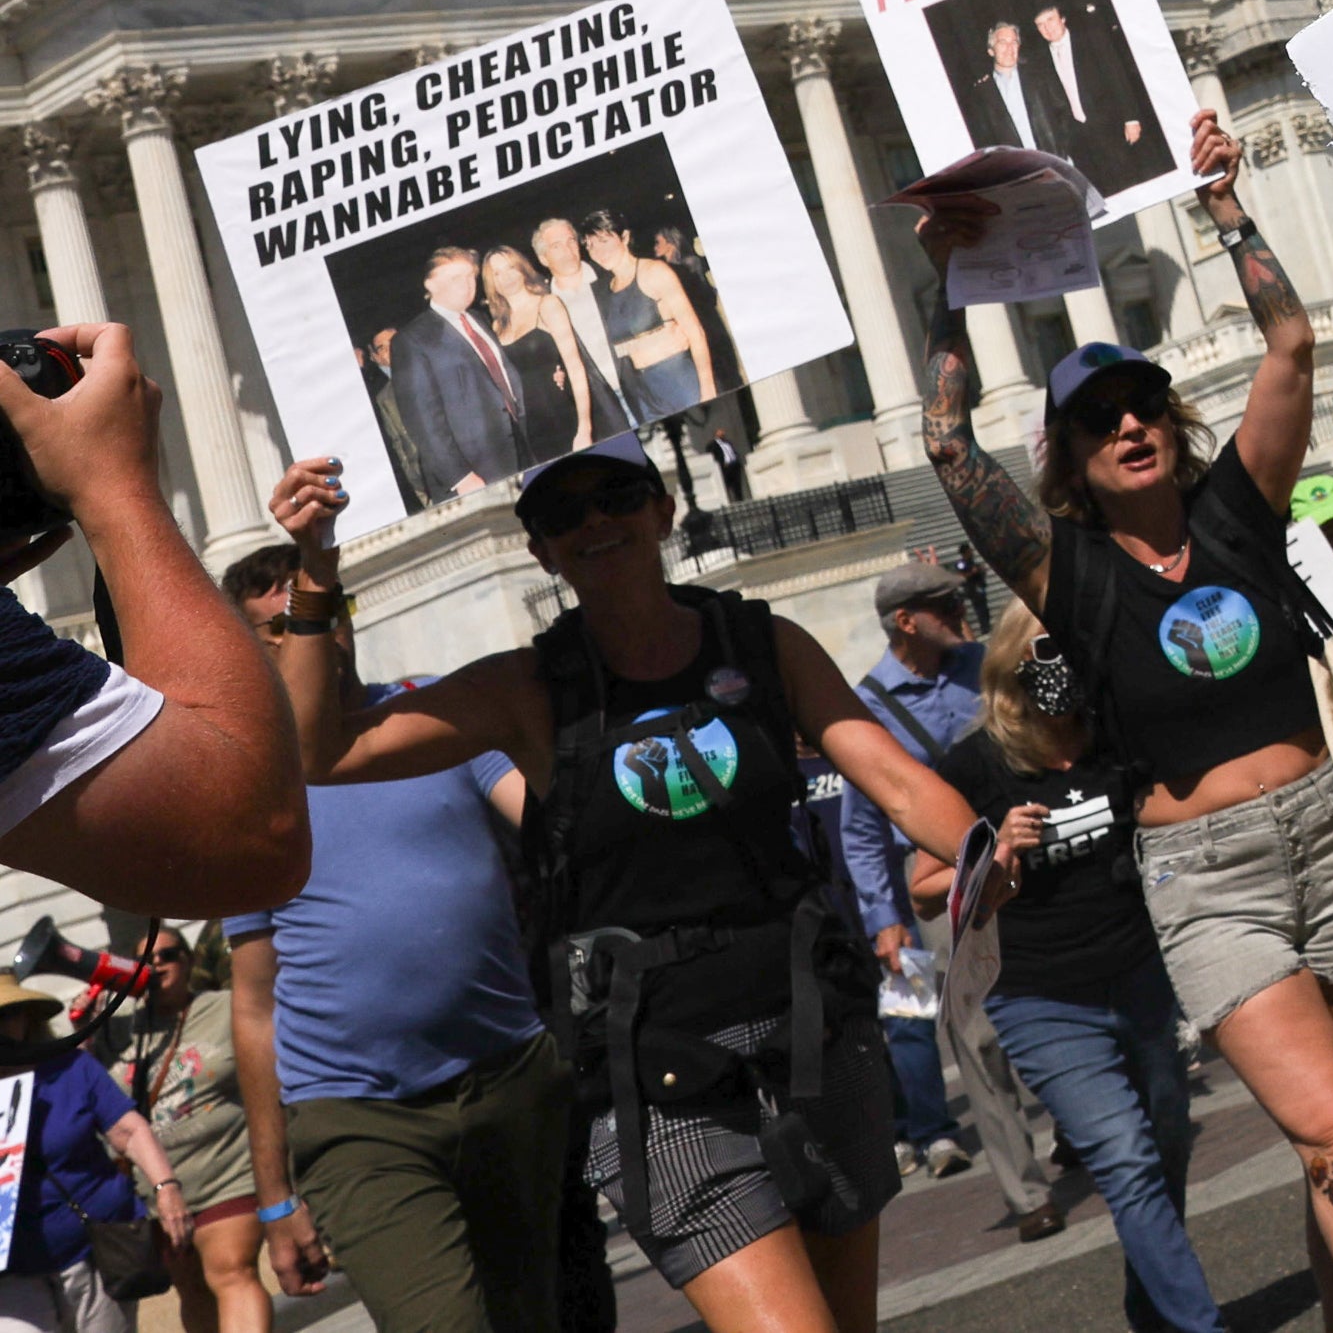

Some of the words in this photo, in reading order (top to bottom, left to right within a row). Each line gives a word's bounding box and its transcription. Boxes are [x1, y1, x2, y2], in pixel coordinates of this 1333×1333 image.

[247, 129, 431, 222] RAPING,
[446, 30, 685, 150] PEDOPHILE
[252, 154, 481, 269] WANNABE
[497, 67, 719, 181] DICTATOR
[257, 92, 400, 170] LYING,
[415, 2, 650, 113] CHEATING,
